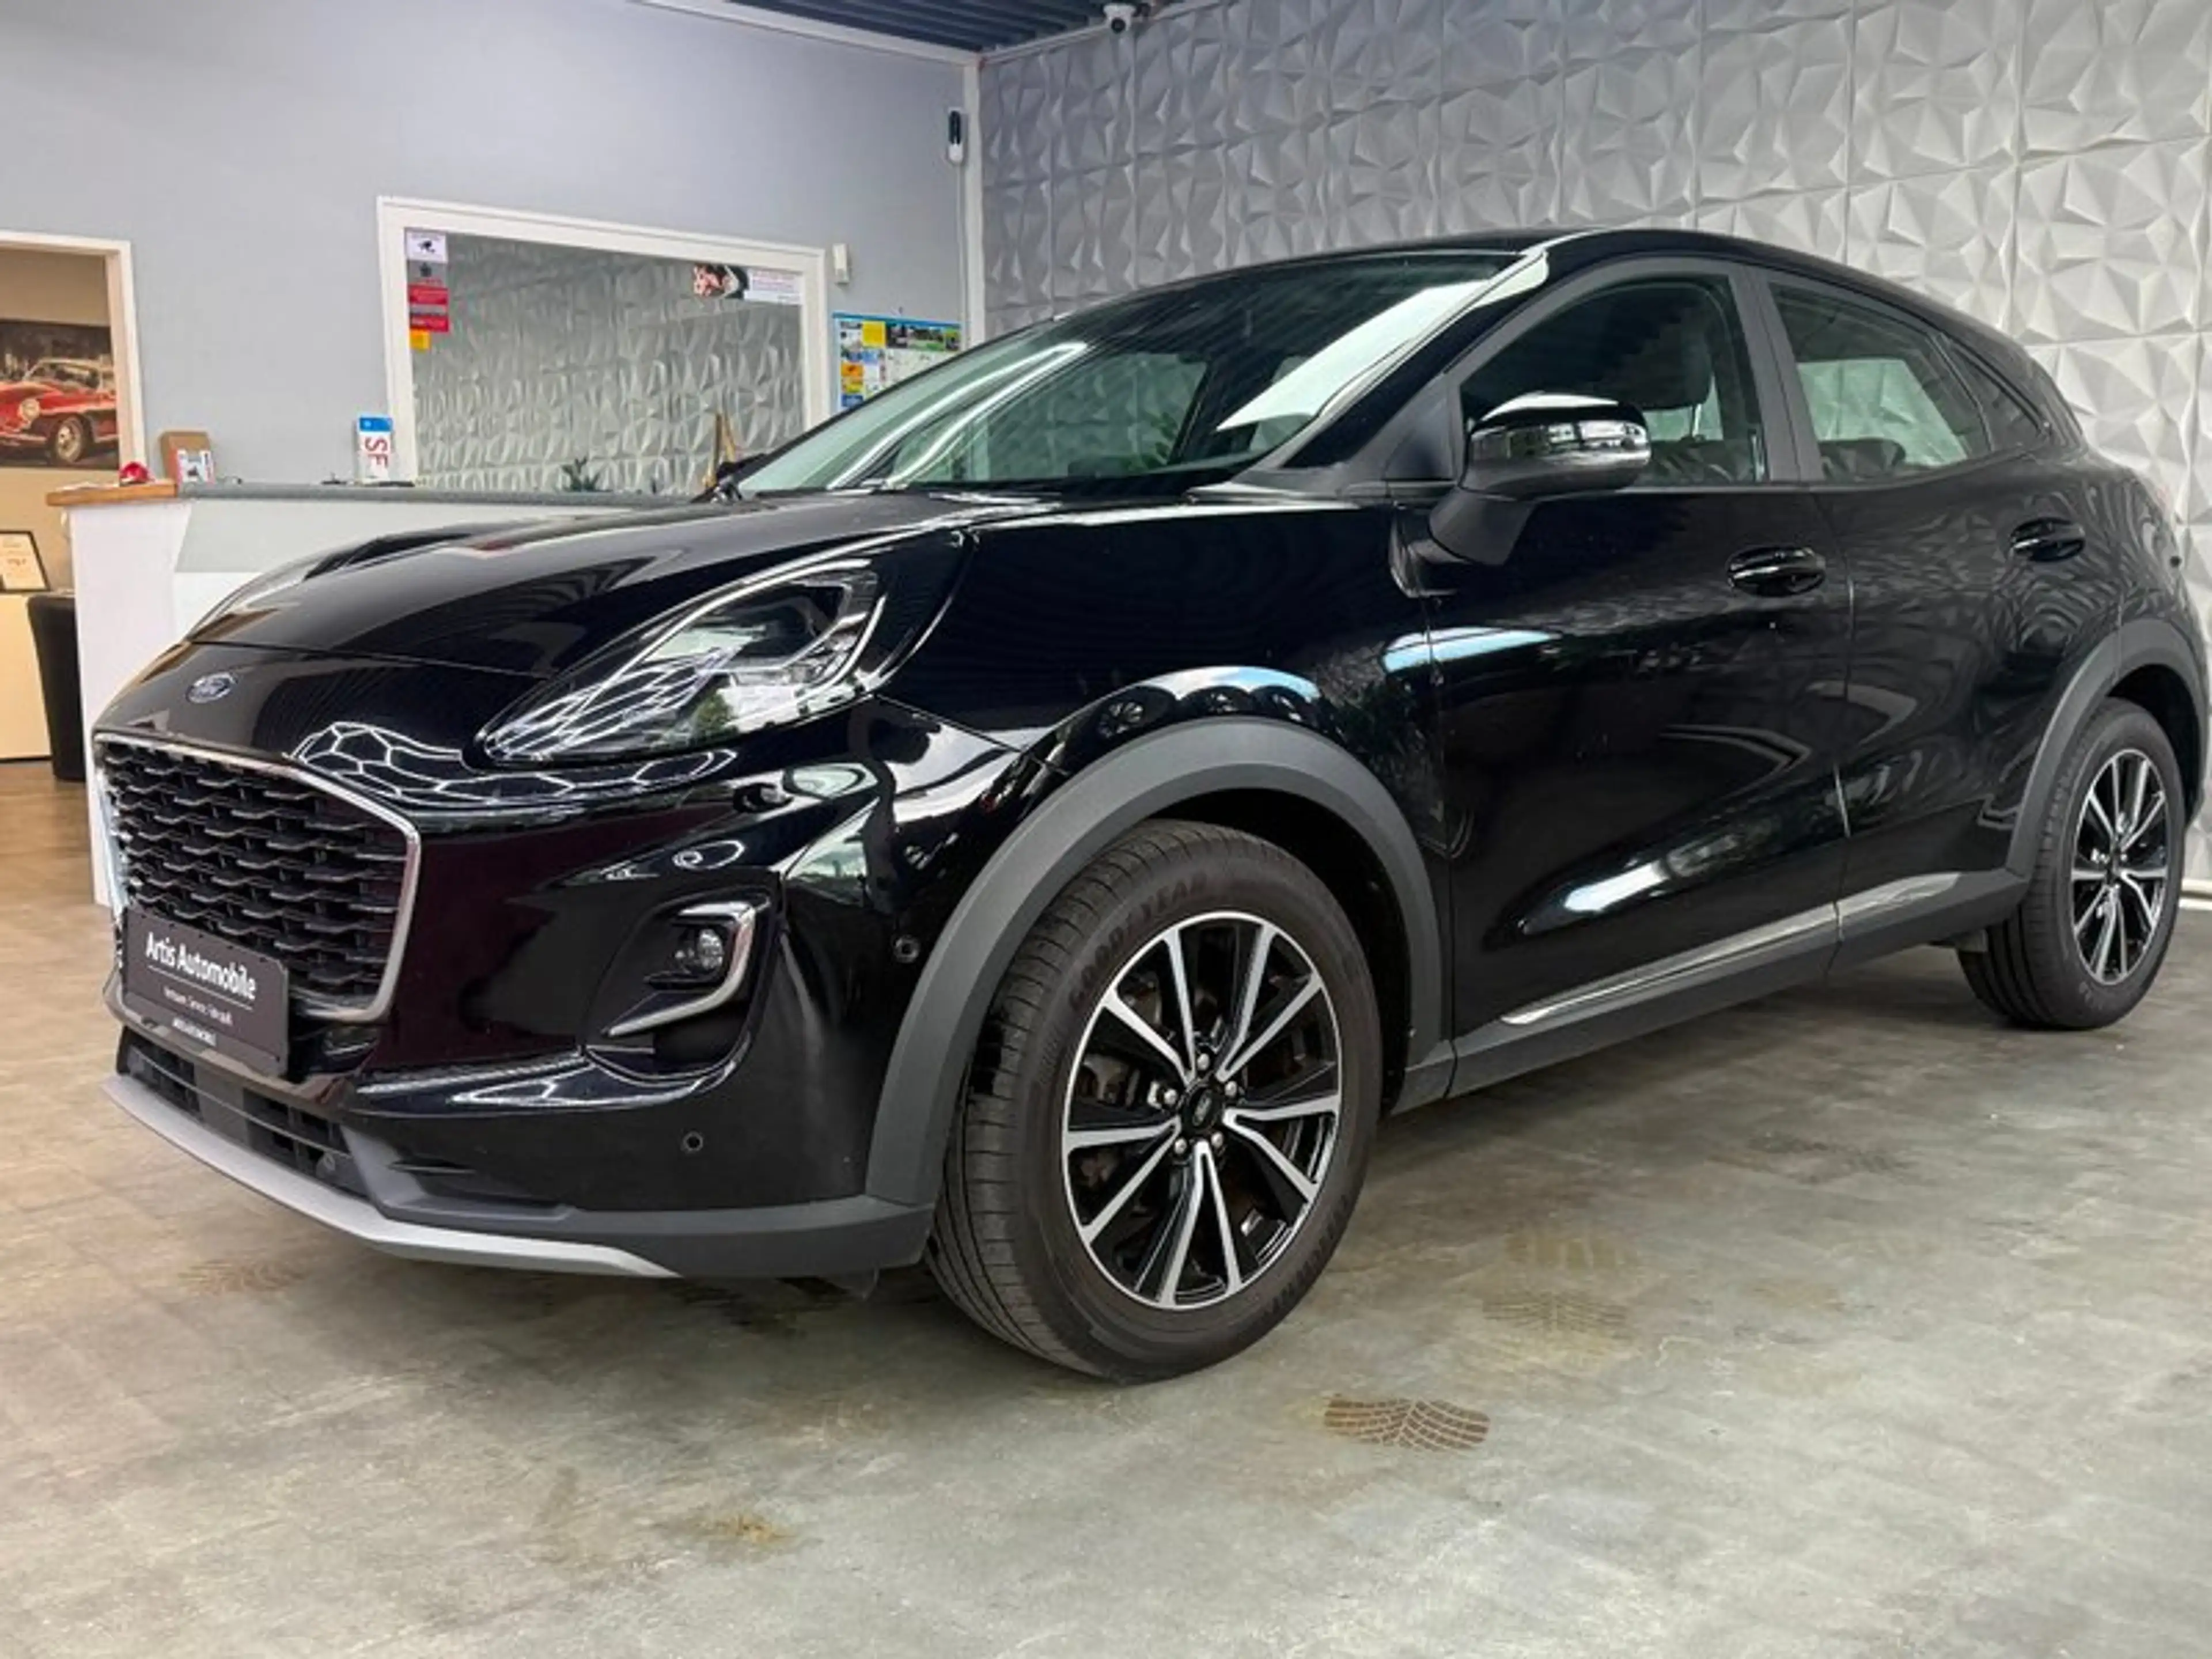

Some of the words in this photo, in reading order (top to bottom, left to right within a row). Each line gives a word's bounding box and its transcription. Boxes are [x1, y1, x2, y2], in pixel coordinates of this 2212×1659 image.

[365, 437, 388, 468] SF
[146, 931, 175, 967] Artis
[177, 942, 256, 1001] Automobile
